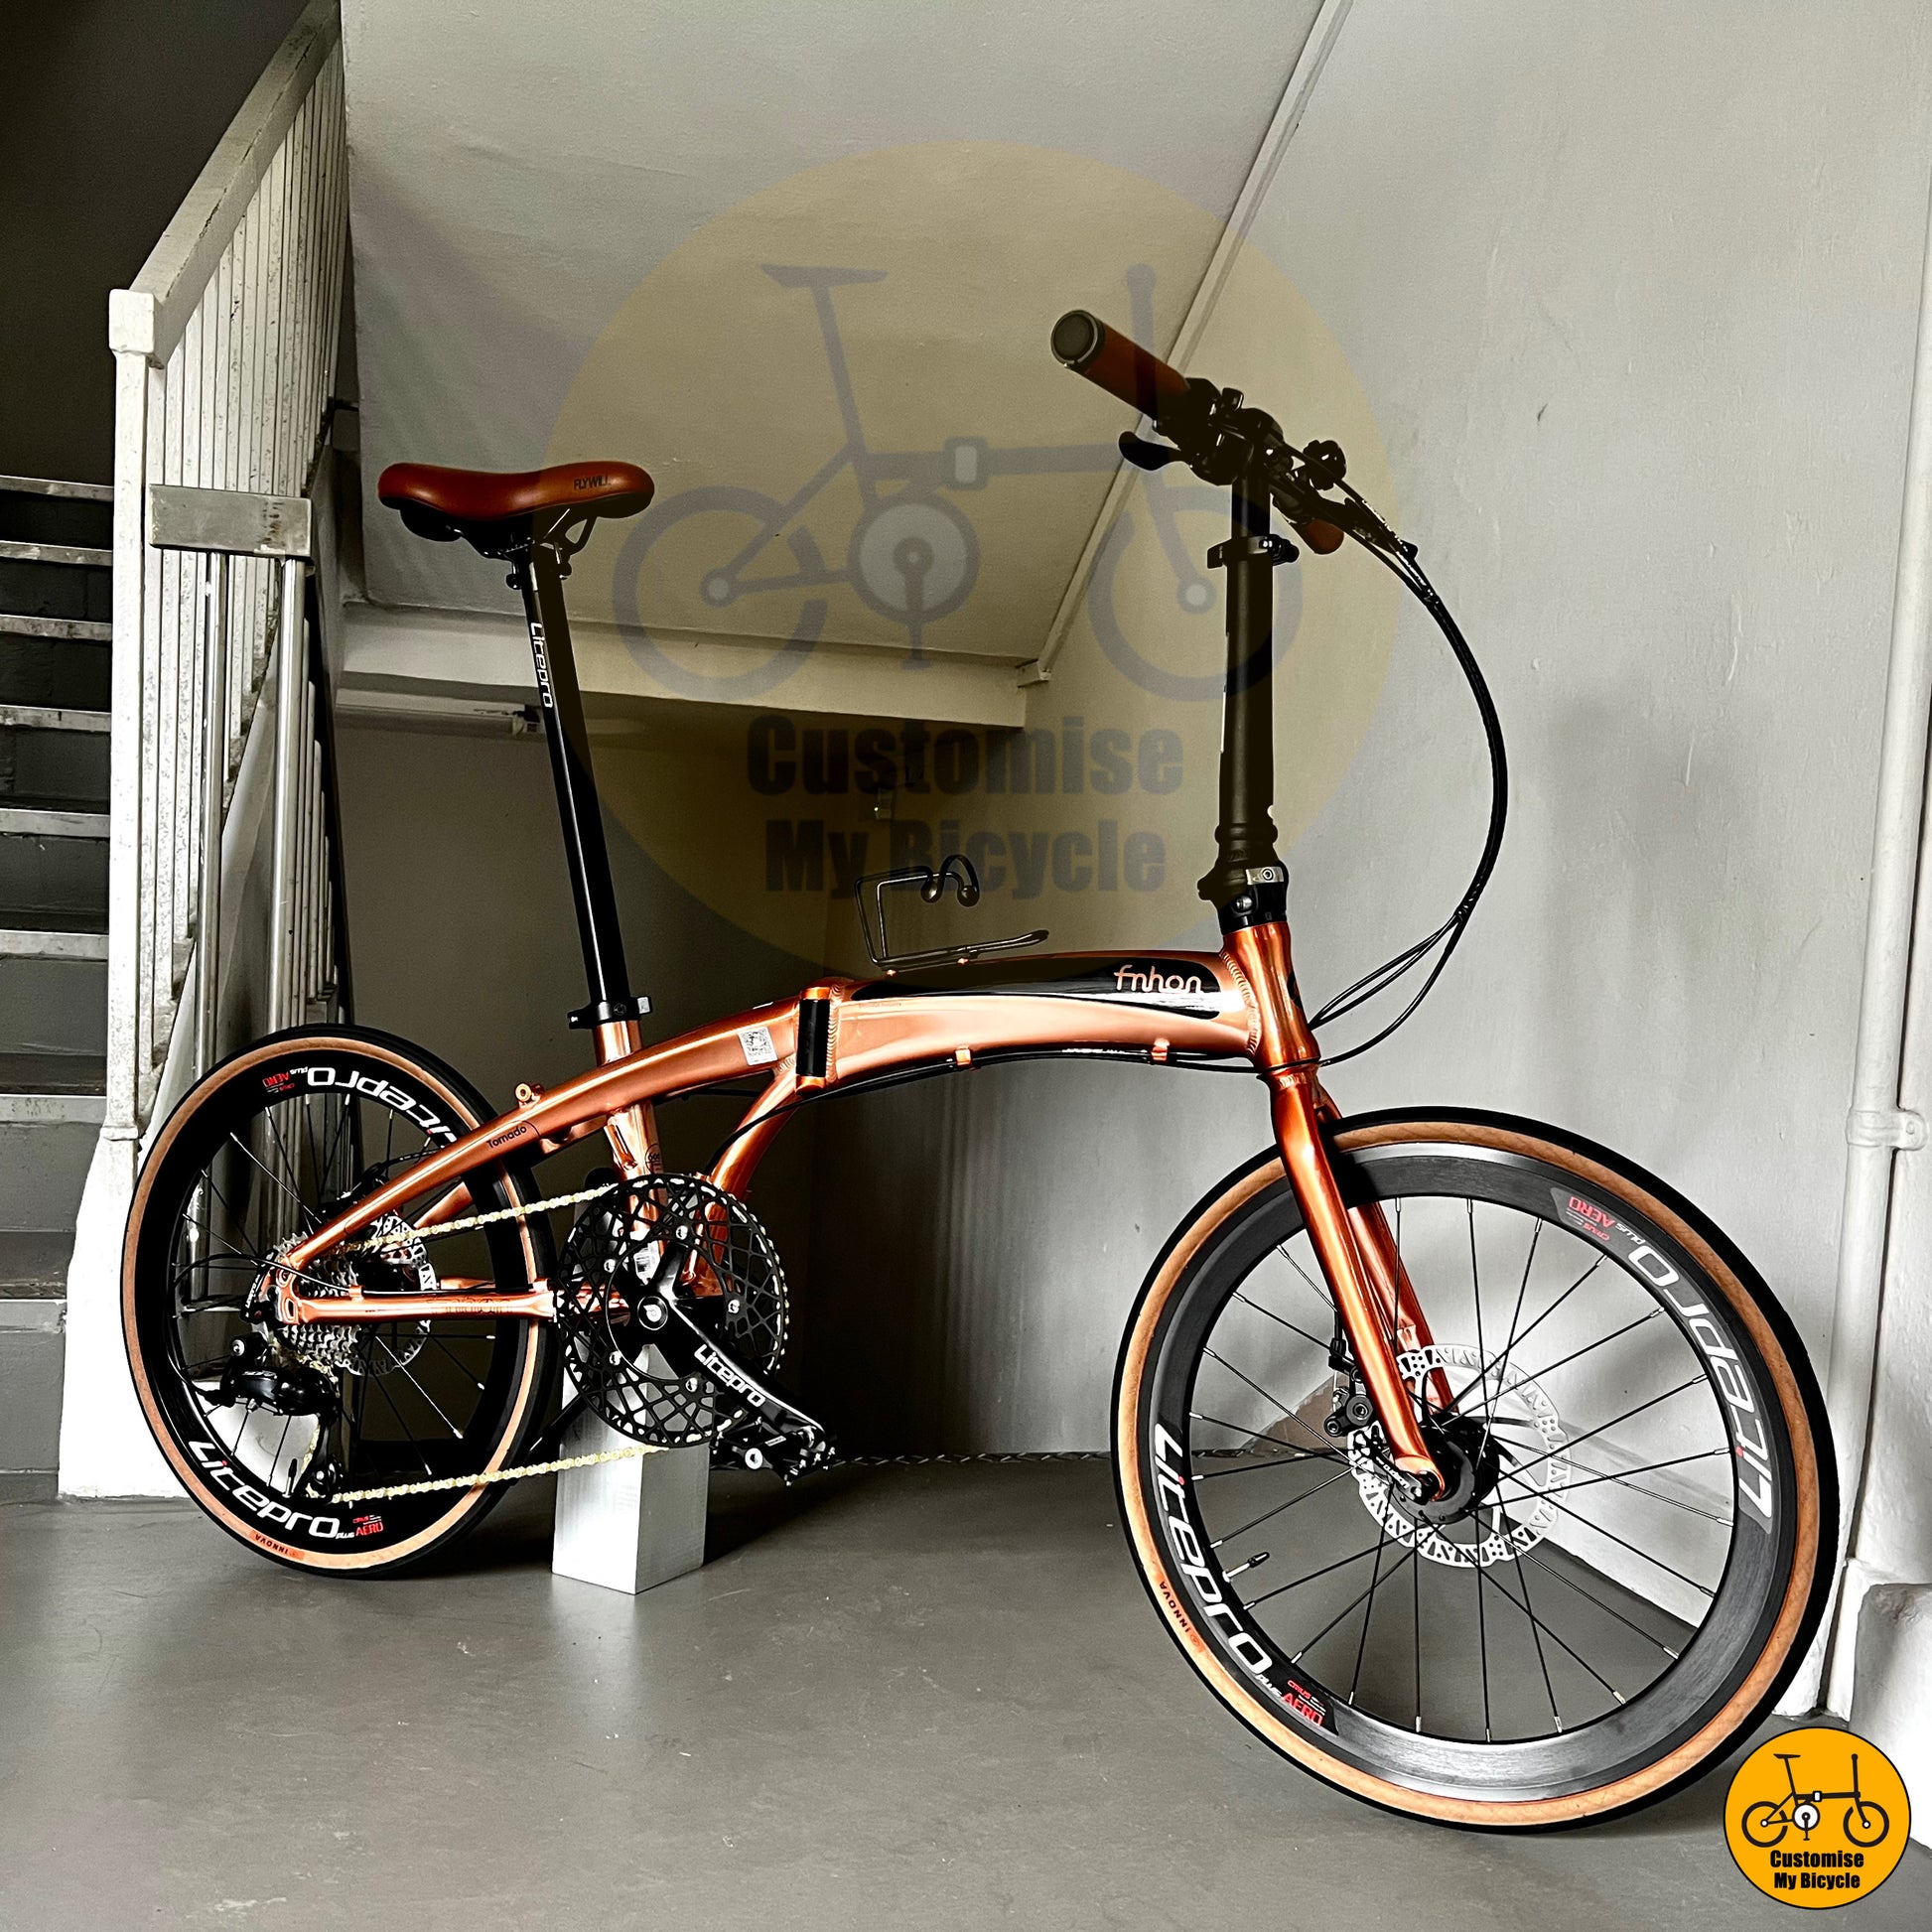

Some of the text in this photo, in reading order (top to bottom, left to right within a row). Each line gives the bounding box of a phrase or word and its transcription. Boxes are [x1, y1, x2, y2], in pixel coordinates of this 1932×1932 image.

[1569, 1196, 1616, 1228] AERO
[255, 1534, 289, 1555] INNOVA
[355, 1521, 384, 1537] AERO
[1160, 1581, 1191, 1633] INNOVA
[1281, 1693, 1323, 1726] AERO
